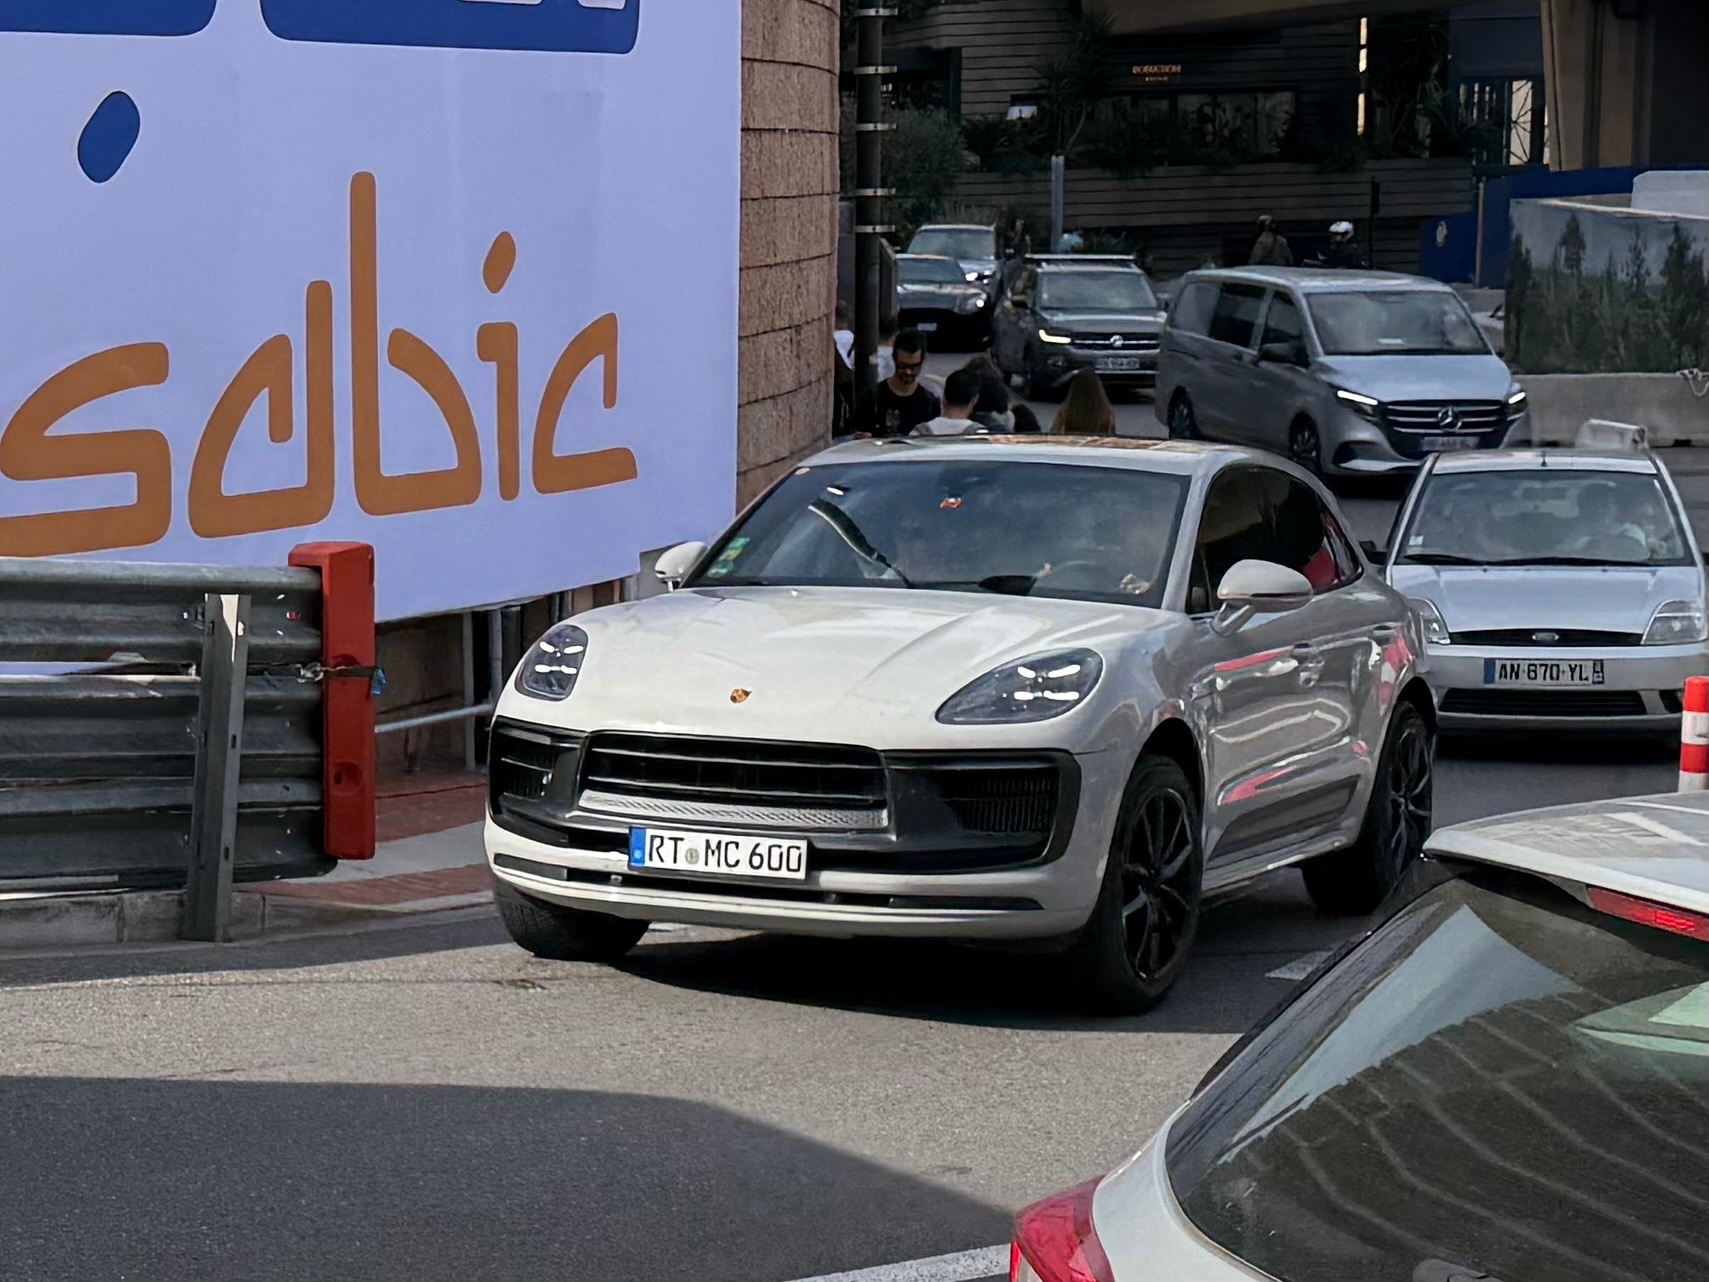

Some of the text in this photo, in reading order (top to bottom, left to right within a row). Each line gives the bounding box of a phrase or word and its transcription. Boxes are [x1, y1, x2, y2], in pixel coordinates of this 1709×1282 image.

[0, 171, 638, 557] sabic
[649, 835, 802, 872] RT MC 600
